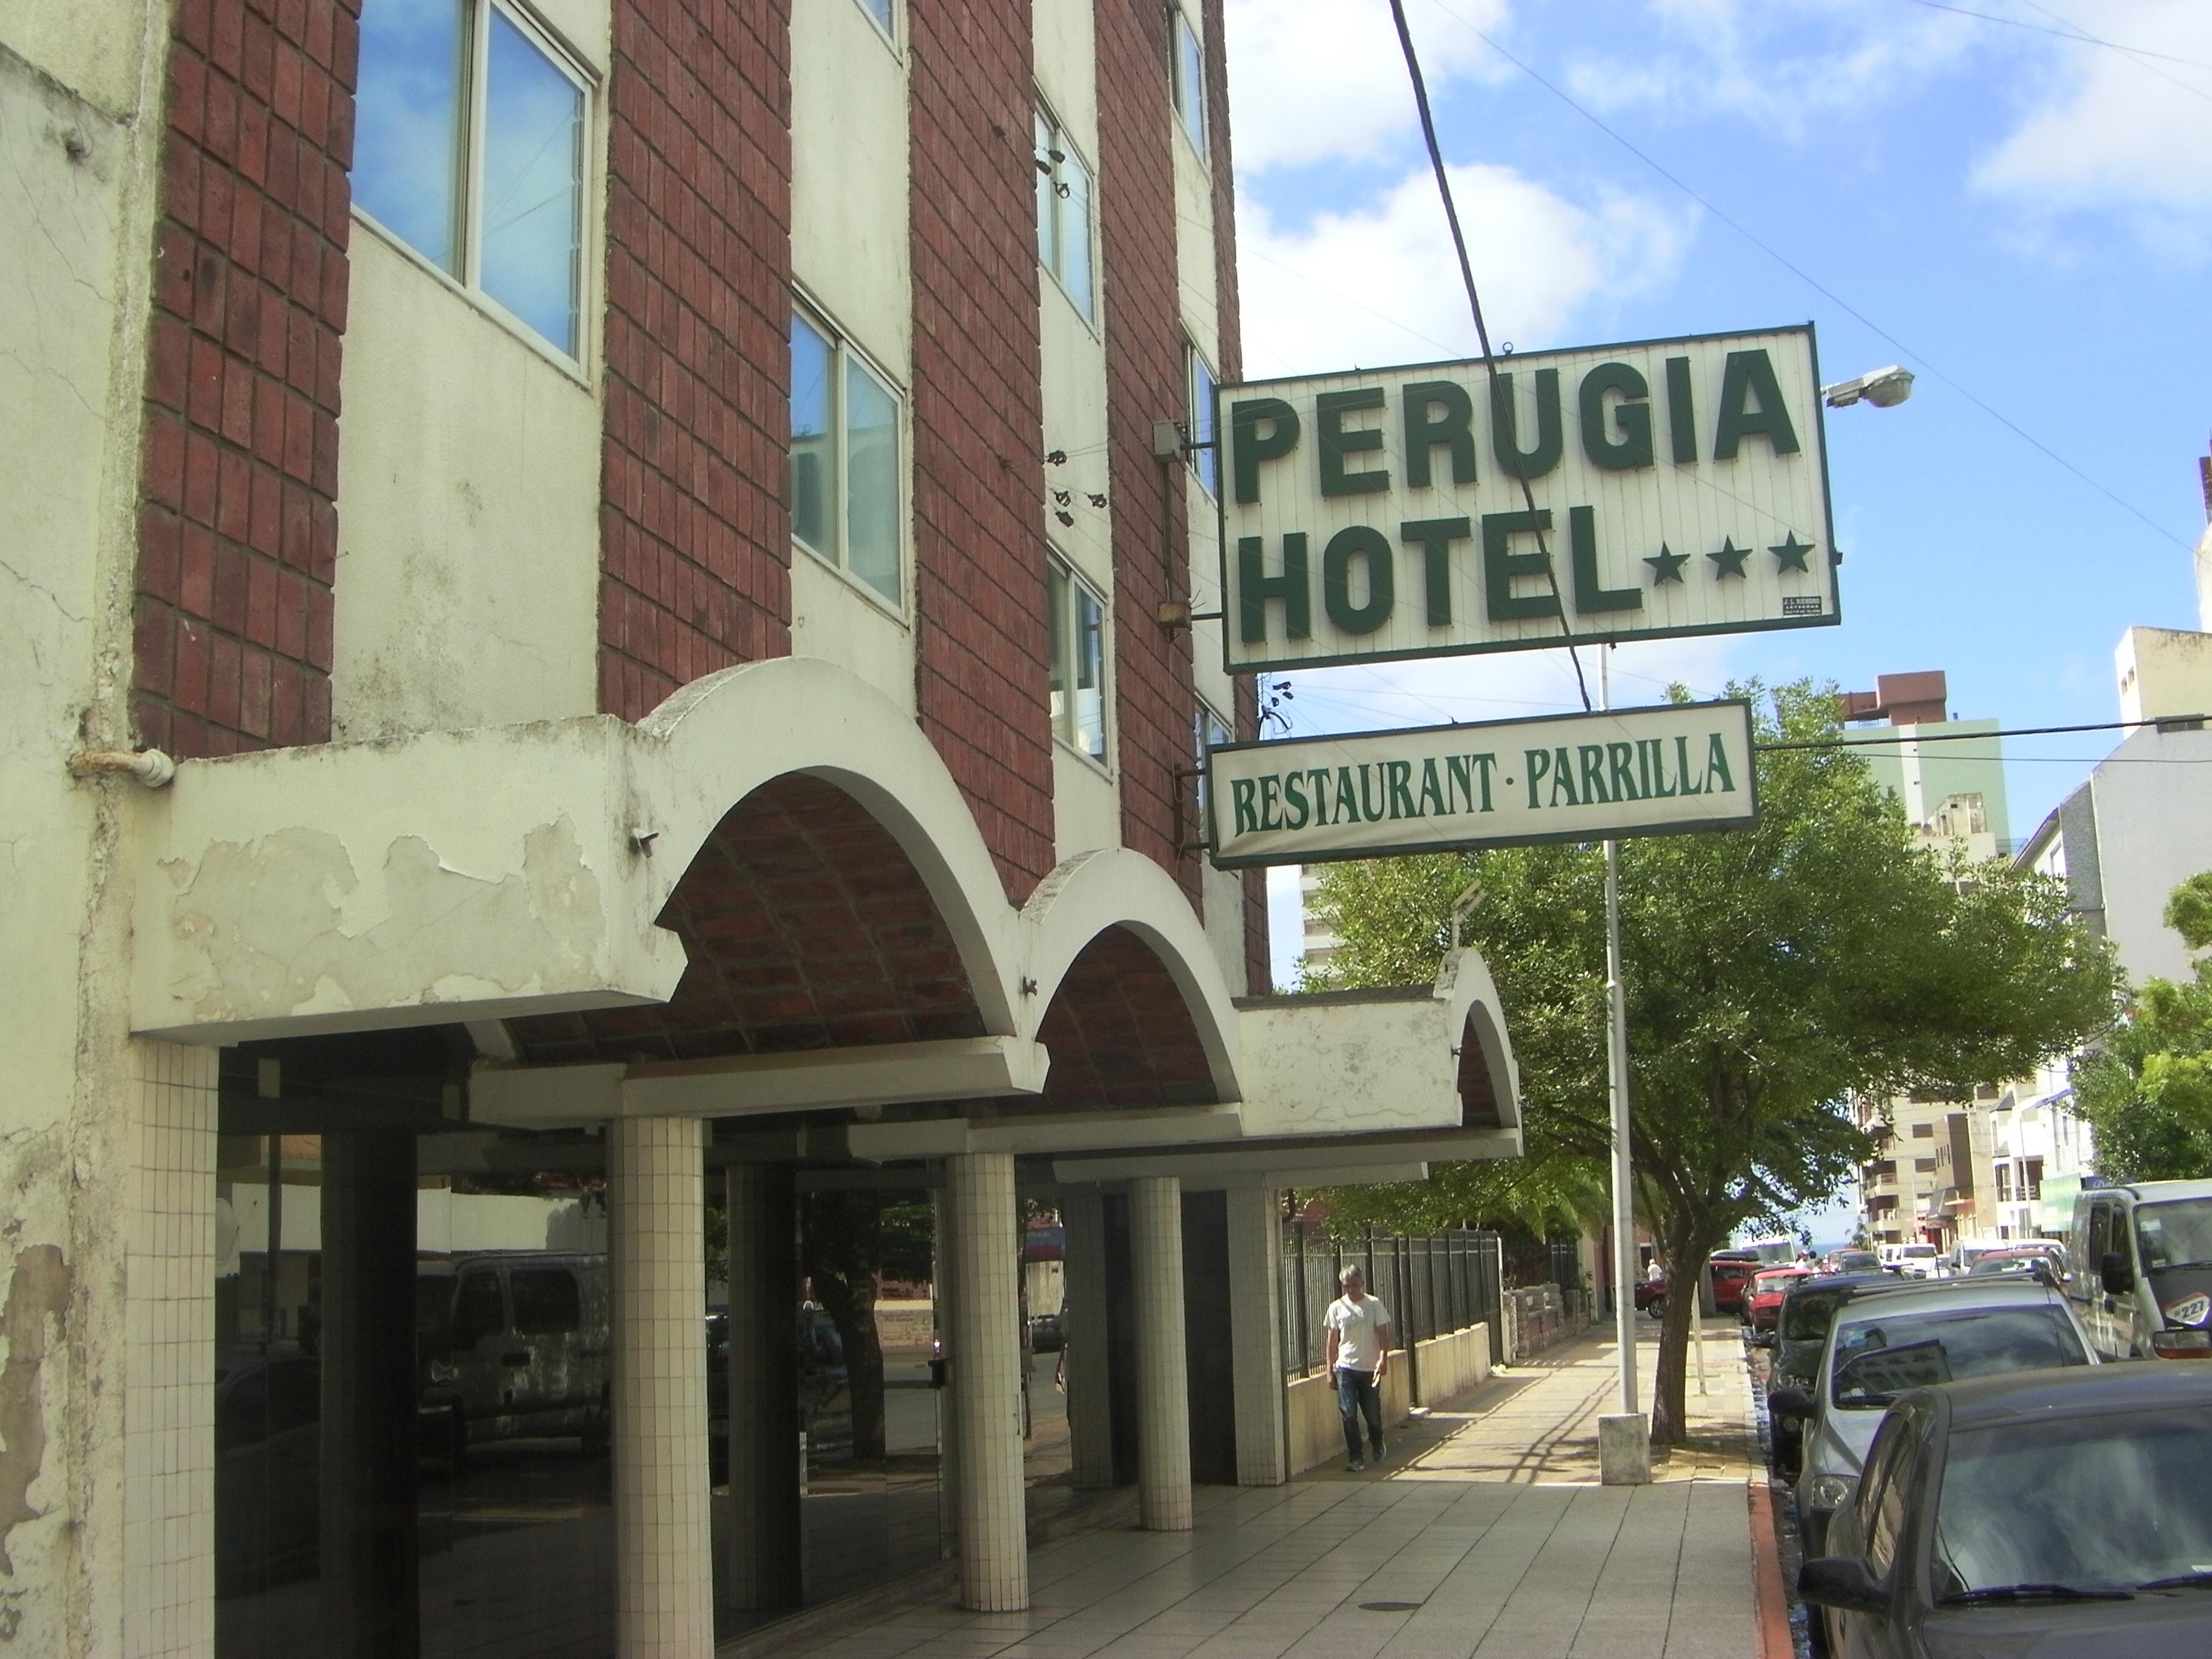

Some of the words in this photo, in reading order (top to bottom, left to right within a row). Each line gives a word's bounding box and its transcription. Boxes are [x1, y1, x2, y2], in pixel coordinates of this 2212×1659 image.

[1232, 349, 1800, 511] PERUGIA
[1238, 505, 1644, 652] HOTEL
[1232, 752, 1498, 837] RESTAURANT
[1524, 732, 1735, 810] PARRILLA
